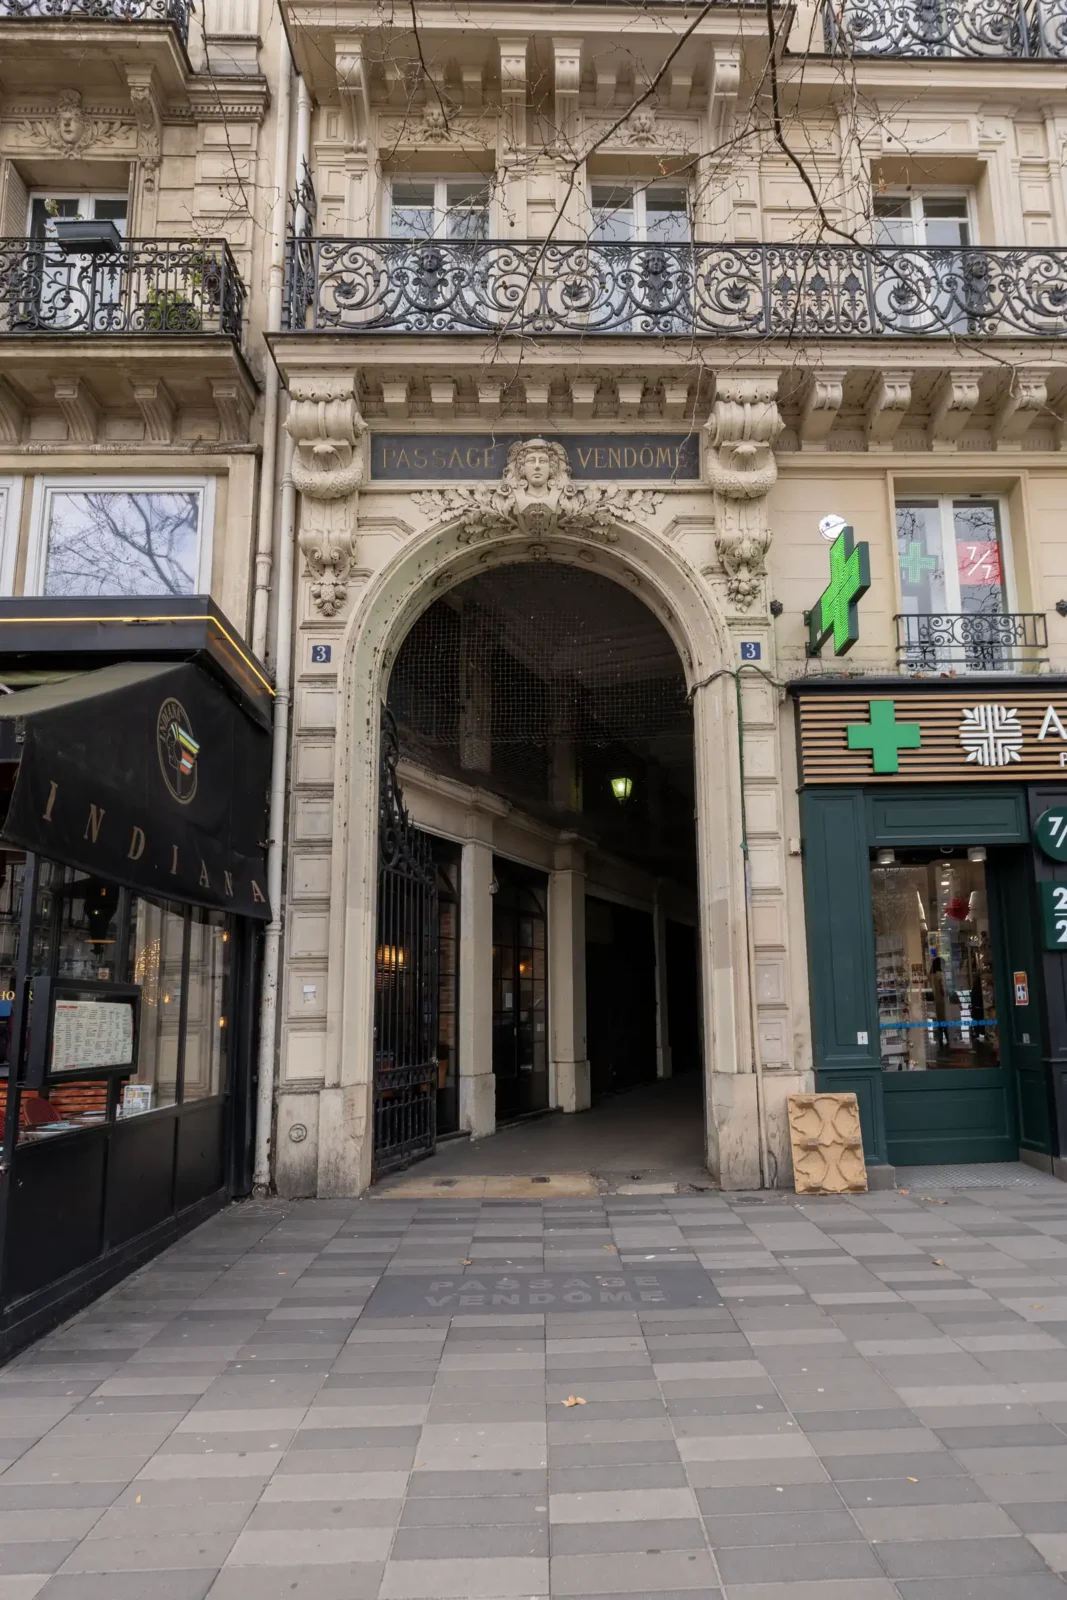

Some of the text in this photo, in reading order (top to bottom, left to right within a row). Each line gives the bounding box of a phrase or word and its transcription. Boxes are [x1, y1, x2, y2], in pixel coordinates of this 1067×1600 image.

[382, 443, 689, 469] PASSAGE VENDÔME
[966, 546, 992, 580] 7/7
[316, 645, 327, 662] 3
[746, 642, 757, 659] 3
[42, 780, 266, 904] INDIANA
[429, 1276, 660, 1292] PASSAGE
[424, 1290, 668, 1307] VENDÔME
